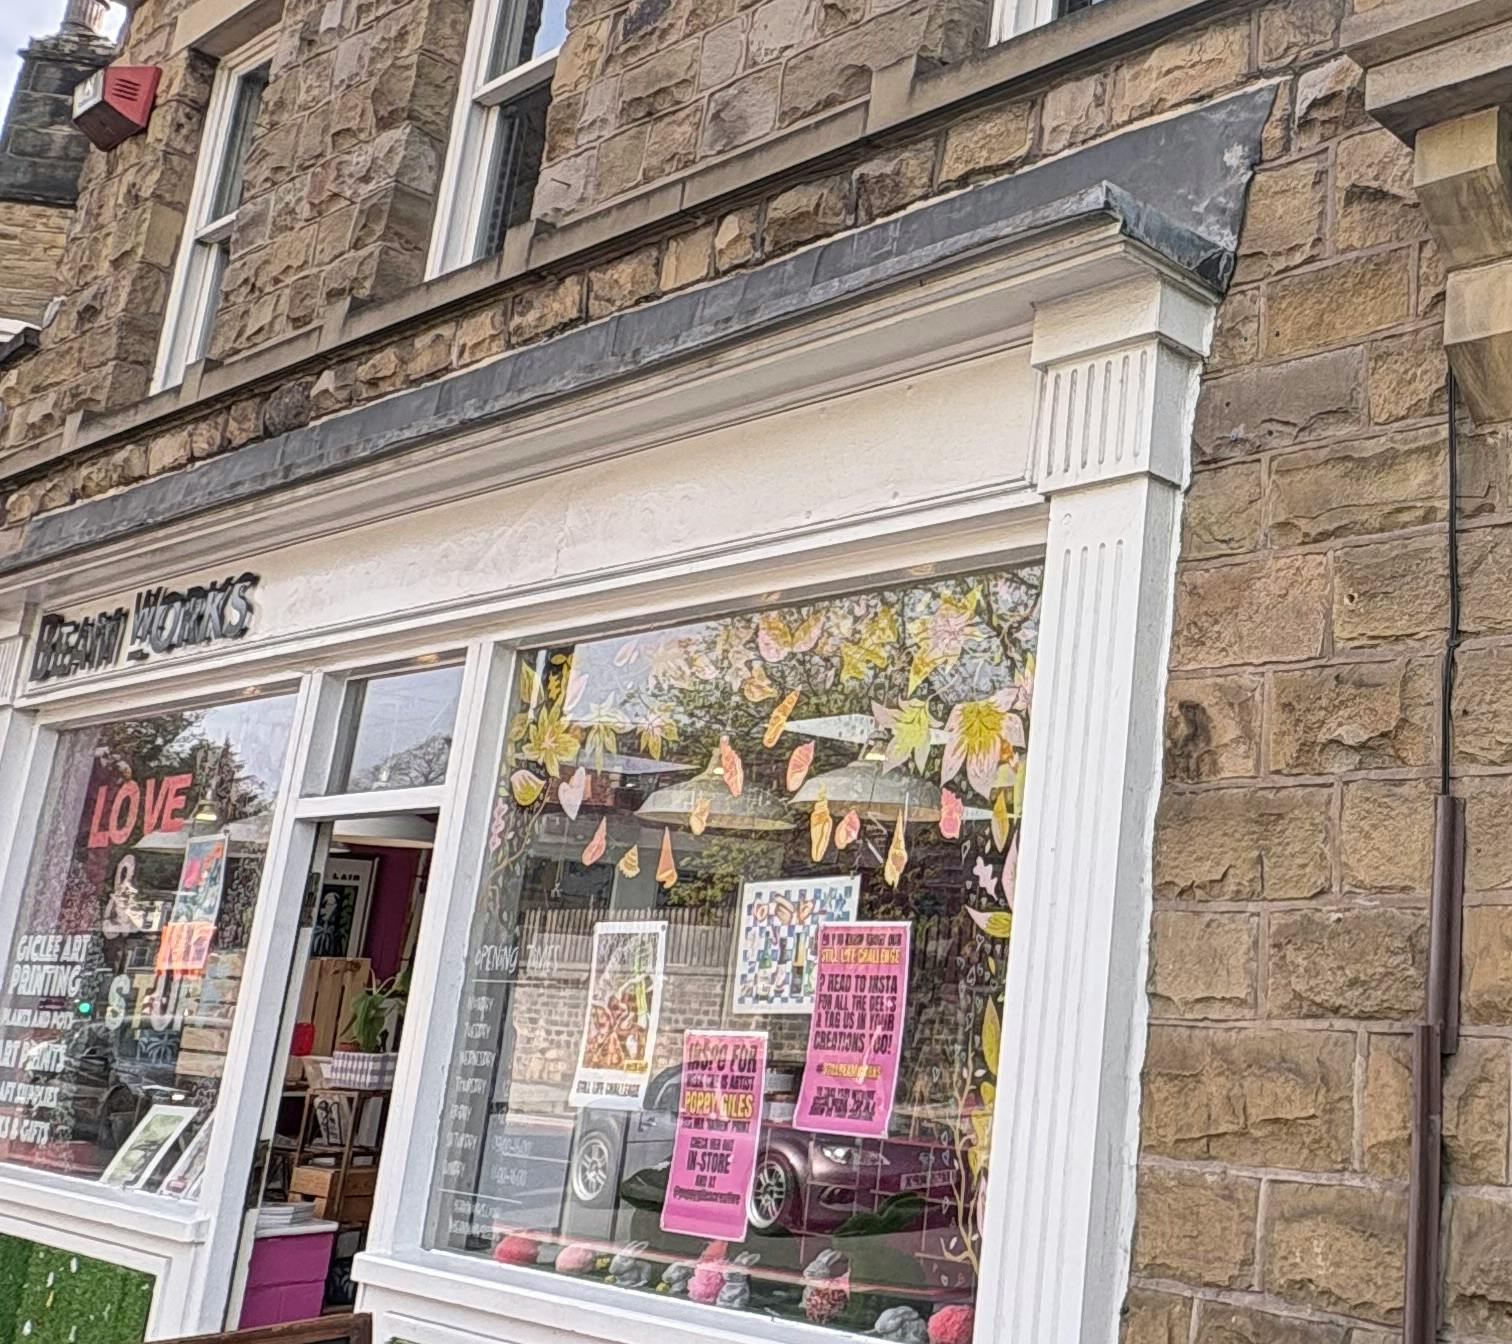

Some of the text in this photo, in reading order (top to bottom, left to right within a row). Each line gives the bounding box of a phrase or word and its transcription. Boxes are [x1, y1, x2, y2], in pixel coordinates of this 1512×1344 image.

[88, 773, 193, 848] LOVE
[60, 934, 92, 962] ART
[475, 944, 519, 974] OPENING
[8, 964, 82, 997] PRINTING
[828, 974, 852, 993] HEAD
[855, 975, 867, 993] TO
[868, 975, 898, 994] INSTA
[818, 994, 833, 1010] FOR
[834, 995, 849, 1011] ALL
[852, 995, 867, 1012] THE
[825, 1012, 841, 1029] TAG
[843, 1012, 855, 1030] US
[856, 1013, 867, 1030] IN
[869, 1013, 895, 1032] YOUR
[814, 1030, 866, 1053] CREATIONS
[730, 1044, 758, 1073] FOR
[729, 1075, 755, 1091] ARTIST
[685, 1090, 754, 1119] POPPY GILES
[687, 1150, 731, 1174] IN-STORE
